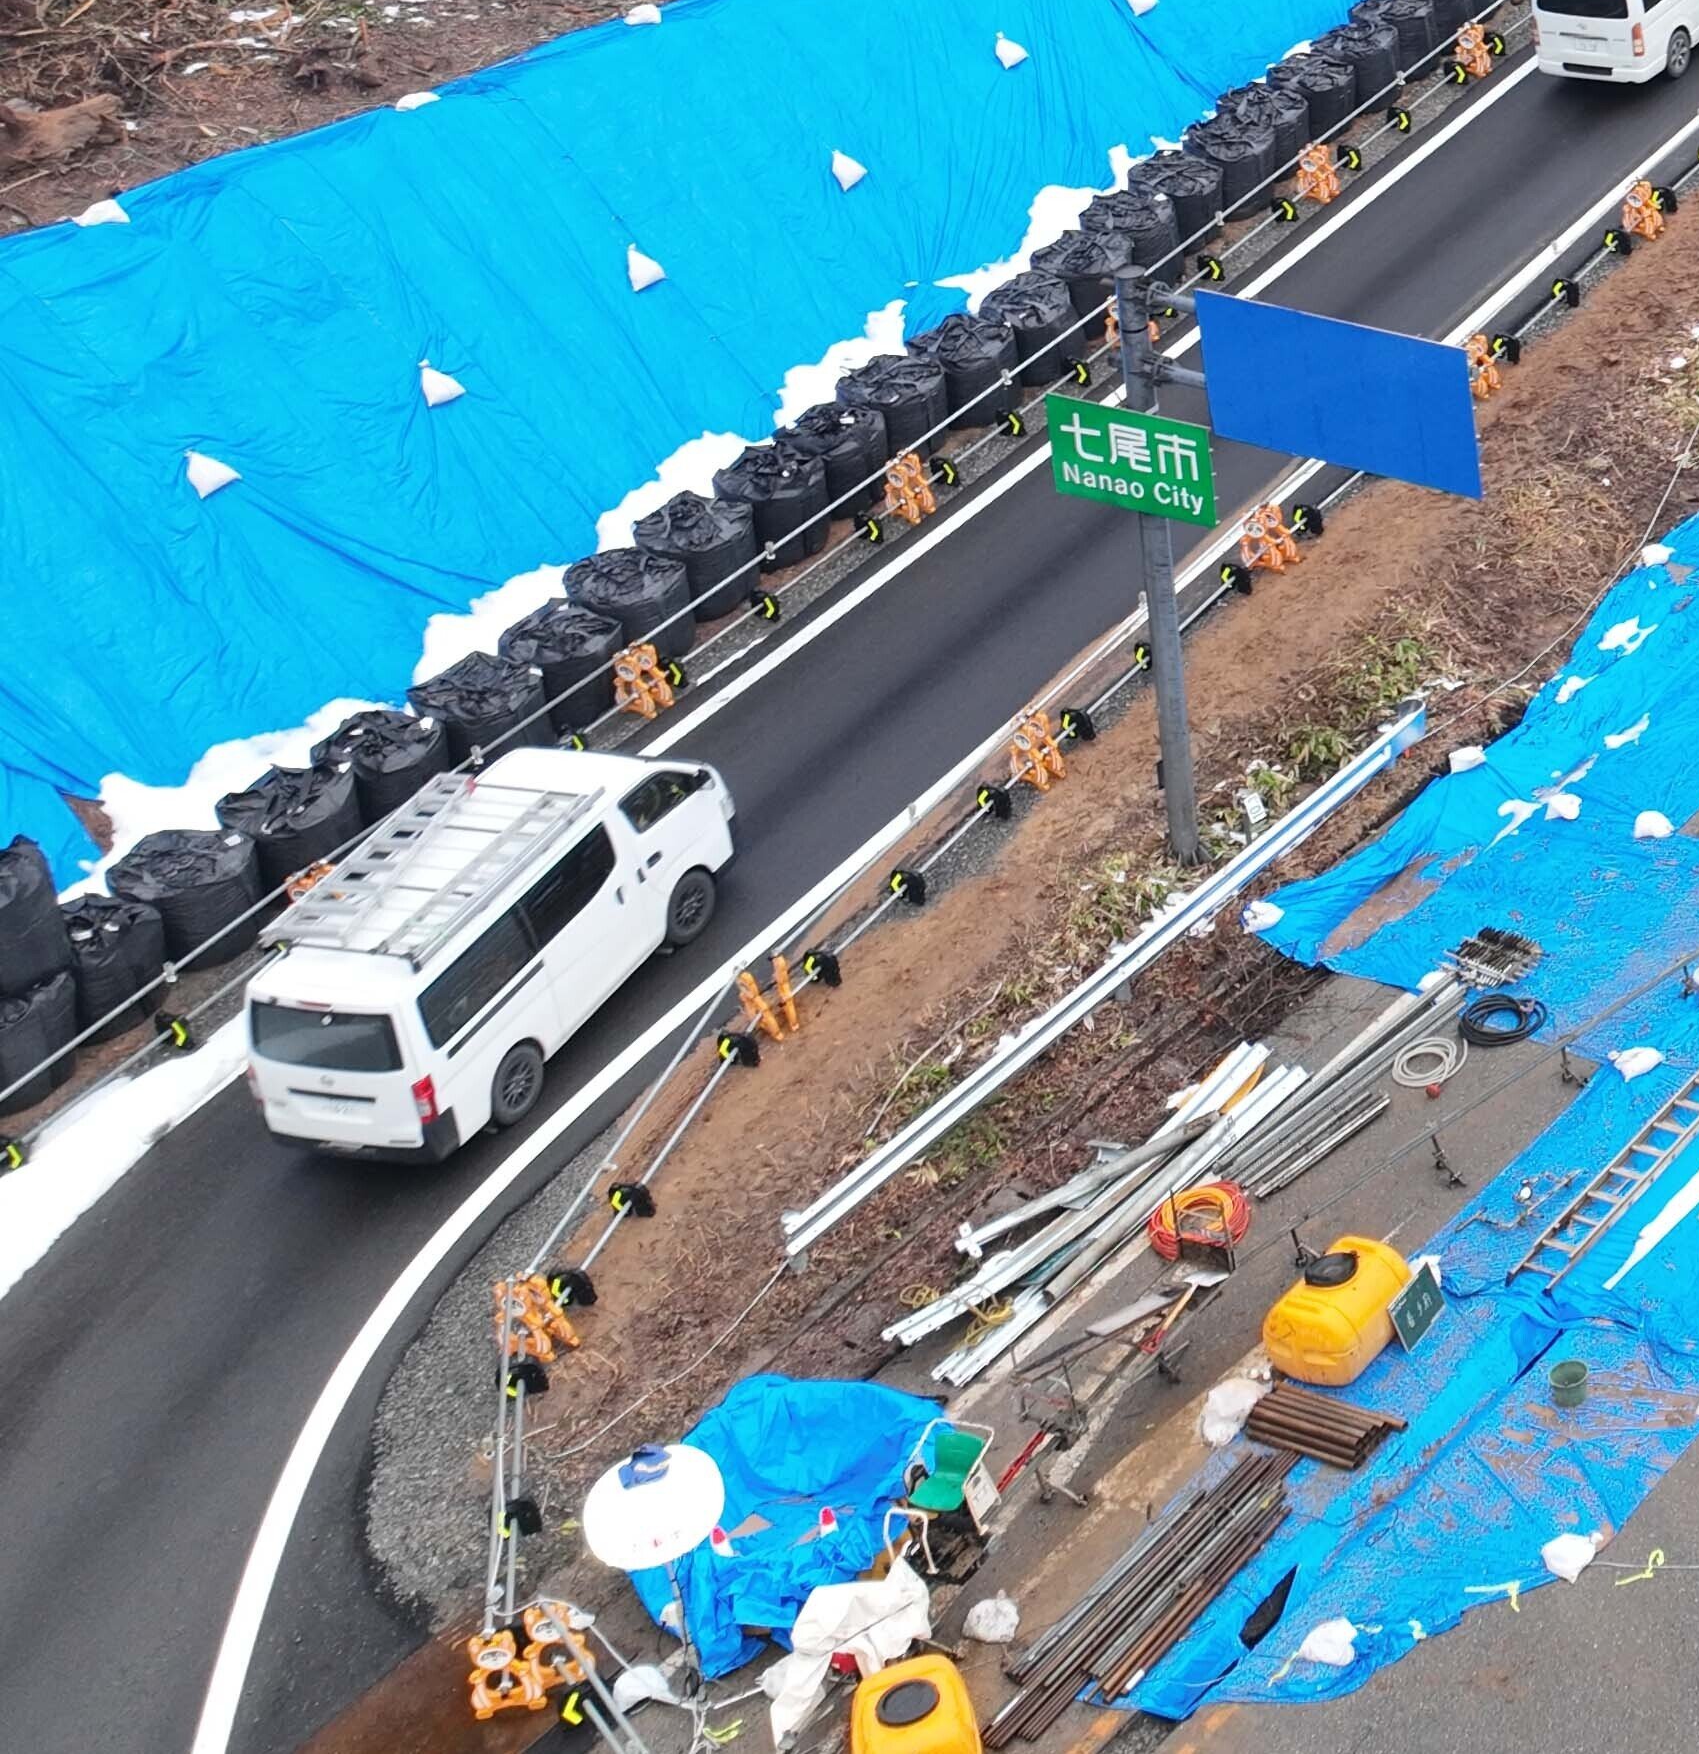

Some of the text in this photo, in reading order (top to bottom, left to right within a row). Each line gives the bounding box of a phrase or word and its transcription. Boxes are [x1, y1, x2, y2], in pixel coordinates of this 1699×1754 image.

[1060, 412, 1199, 481] 七尾市
[1062, 461, 1203, 515] Nanao City
